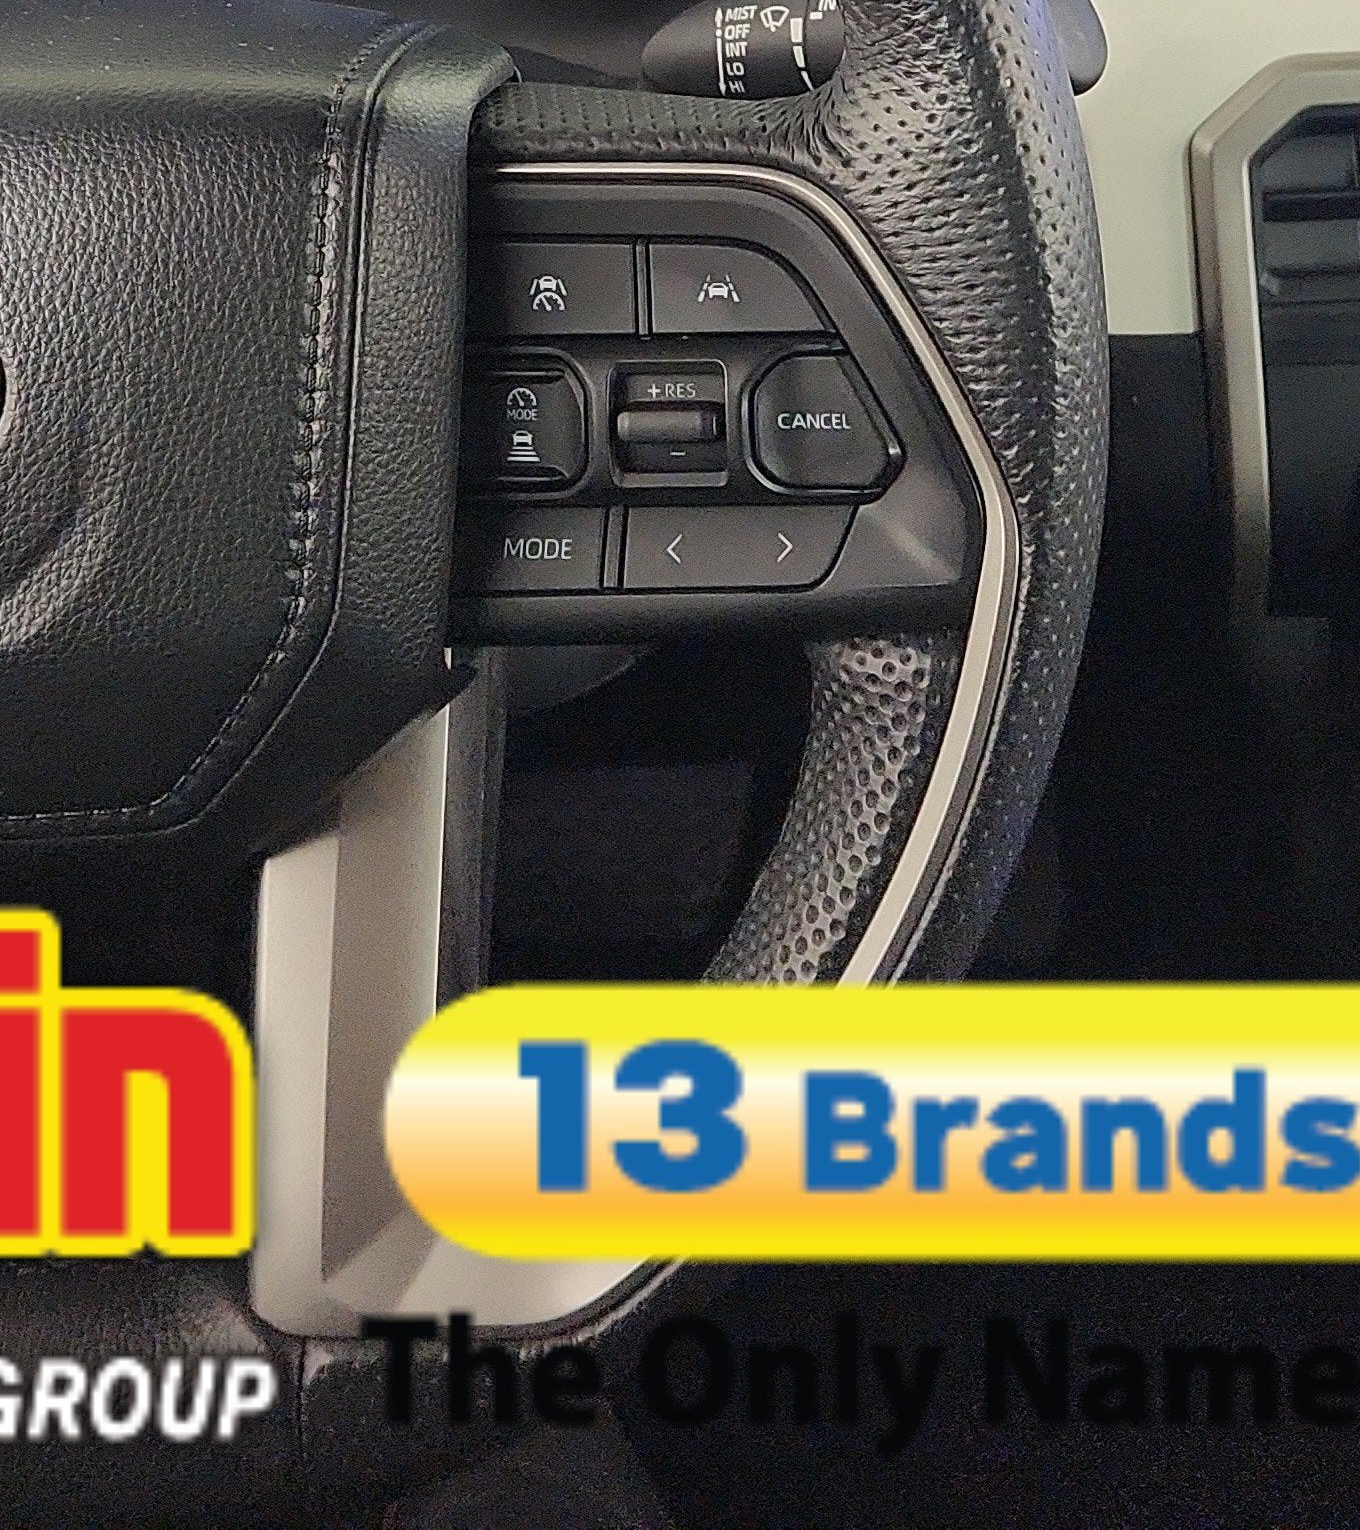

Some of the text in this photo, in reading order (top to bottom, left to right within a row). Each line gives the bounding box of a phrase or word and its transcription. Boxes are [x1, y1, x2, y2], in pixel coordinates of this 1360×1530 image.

[725, 5, 758, 22] MIST
[724, 23, 751, 40] OFF
[725, 41, 748, 58] INT
[726, 61, 745, 76] LO
[728, 80, 746, 93] HI
[506, 408, 539, 422] MODE
[776, 411, 852, 431] CANCEL
[503, 537, 574, 561] MODE
